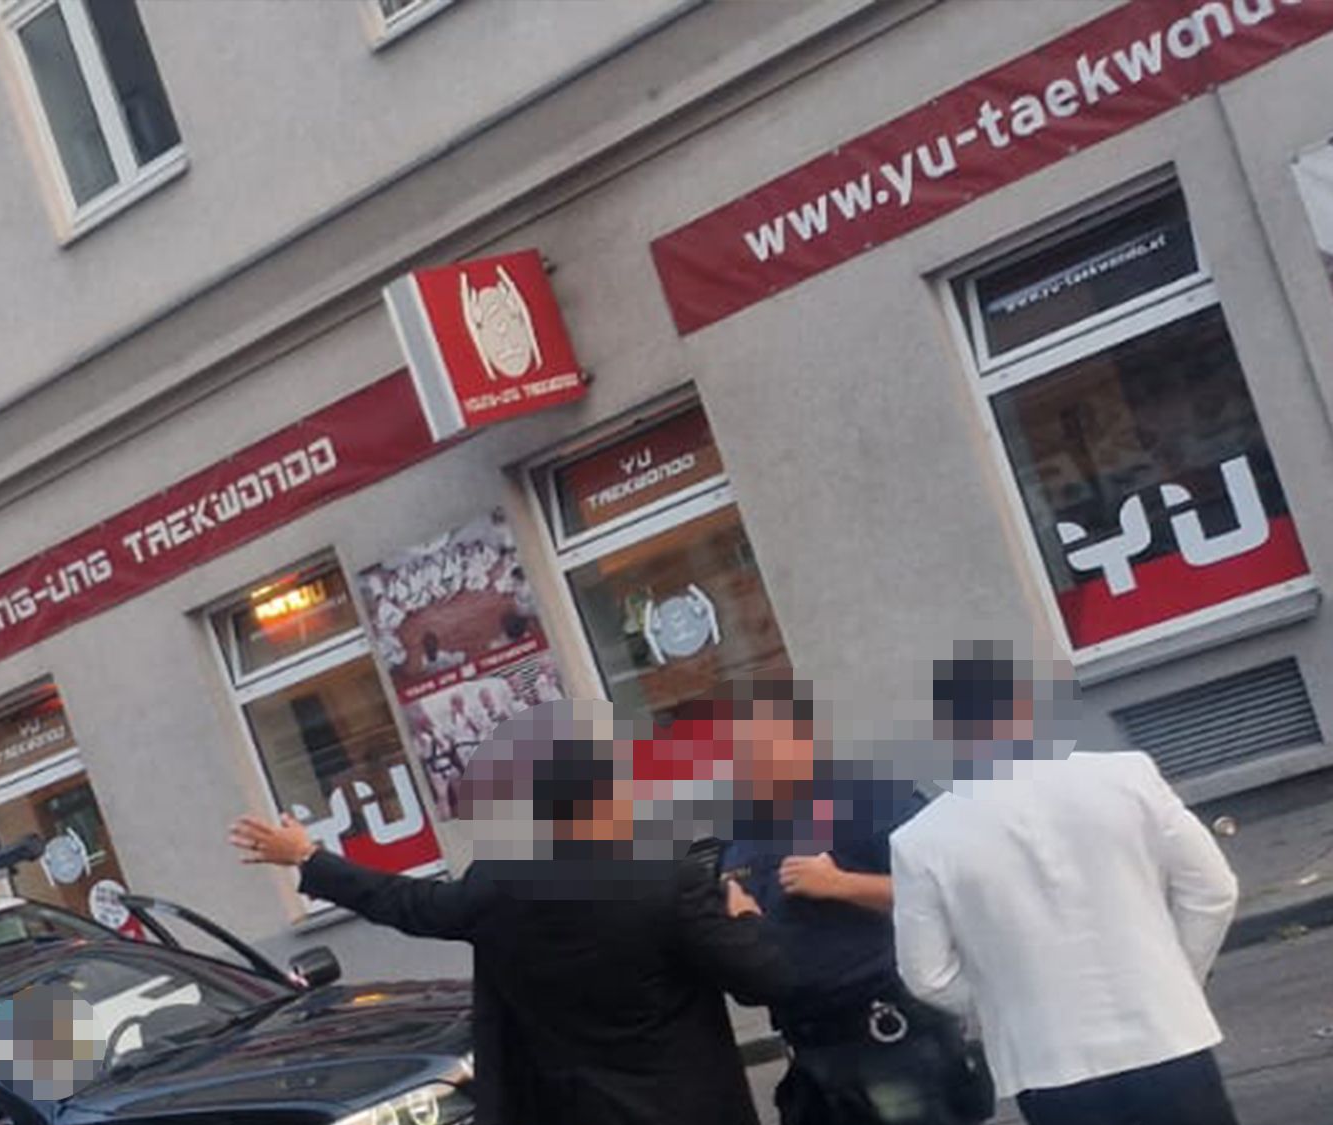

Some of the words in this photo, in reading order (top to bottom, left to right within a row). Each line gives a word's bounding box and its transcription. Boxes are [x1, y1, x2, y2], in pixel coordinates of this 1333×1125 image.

[743, 0, 1302, 262] www.yu-taekwon
[122, 436, 338, 563] TAEKWONDO
[619, 448, 652, 474] YU
[1055, 454, 1270, 597] YU
[291, 763, 425, 857] YU
